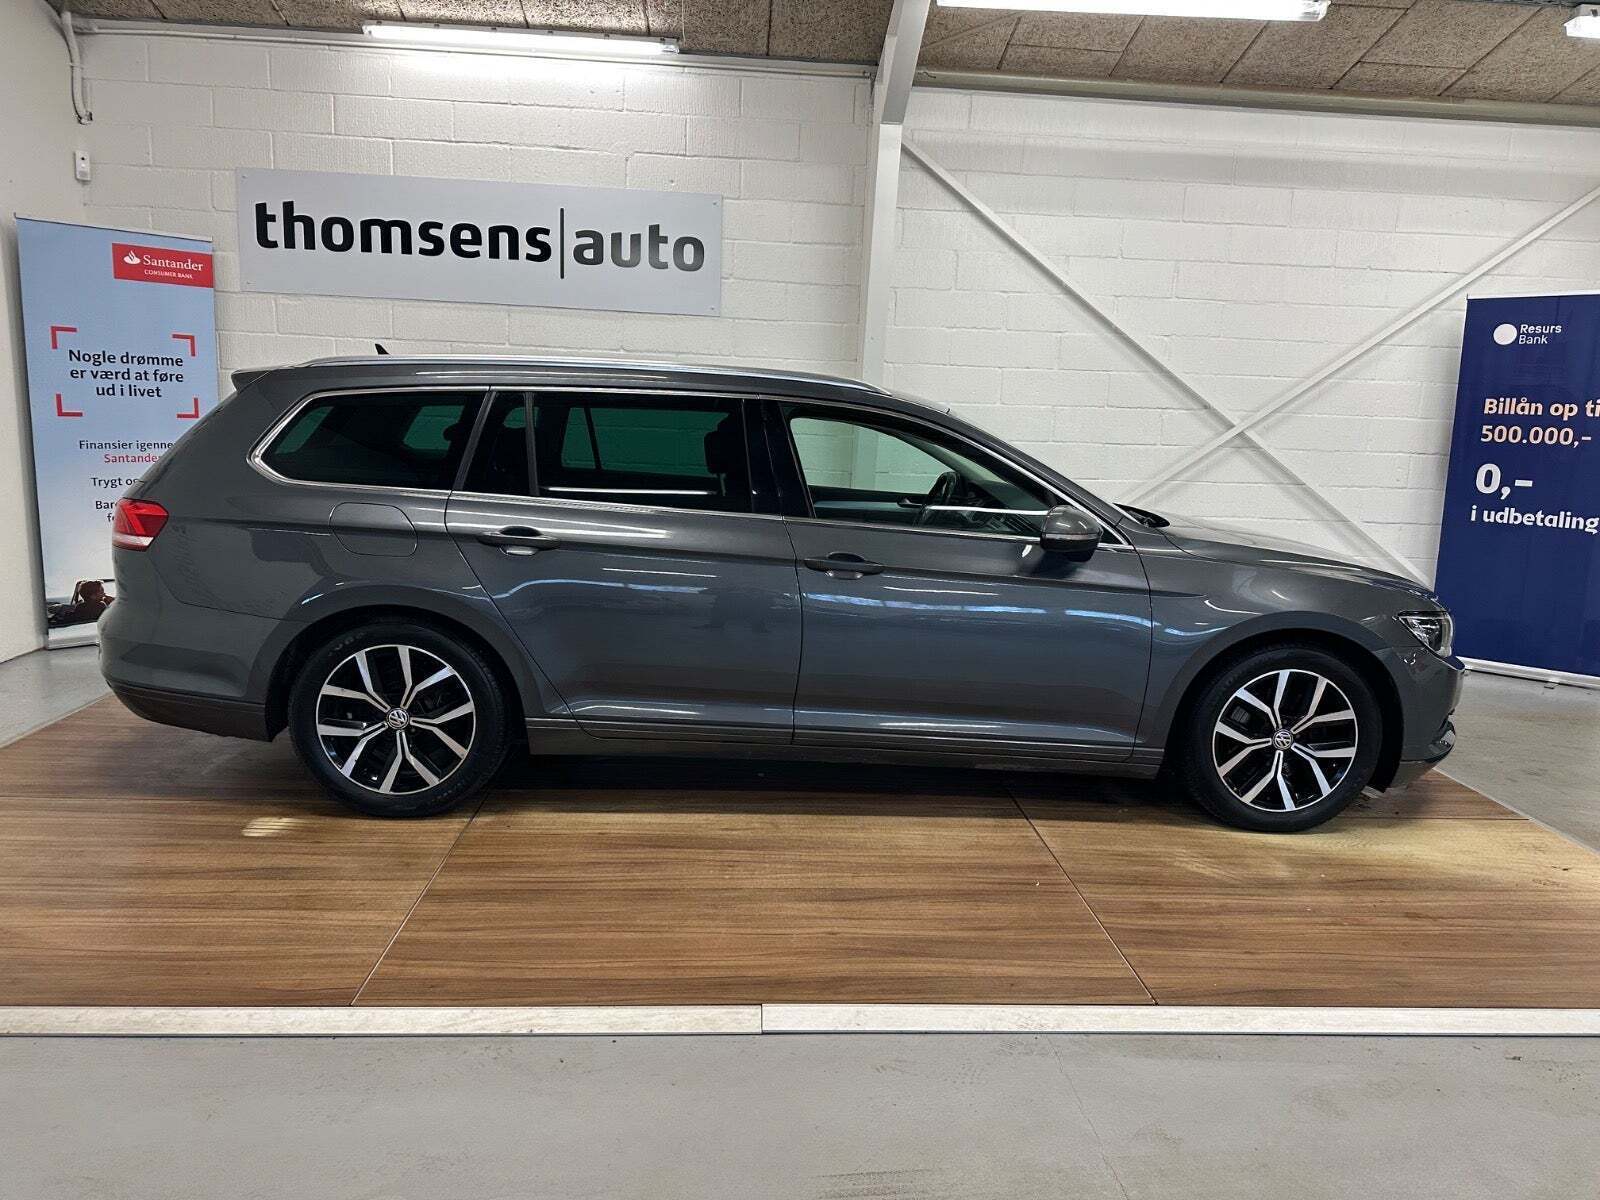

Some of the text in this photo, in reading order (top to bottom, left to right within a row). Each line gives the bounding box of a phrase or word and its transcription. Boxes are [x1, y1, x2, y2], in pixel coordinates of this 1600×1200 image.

[572, 223, 705, 272] auto
[143, 254, 204, 271] Santander
[144, 269, 177, 277] CONSUMER
[1519, 323, 1562, 334] Resurs
[1518, 334, 1549, 345] Bank
[68, 349, 184, 367] Nogle drømme
[70, 367, 184, 383] er værd at føre
[96, 384, 162, 398] ud i livet
[1483, 396, 1543, 416] Billån
[1549, 403, 1578, 421] op
[1480, 424, 1592, 448] 500.000,-
[79, 440, 175, 452] Finansier igenne
[104, 453, 160, 464] Santande
[90, 477, 123, 489] Trygt
[95, 500, 117, 510] Bar
[1470, 505, 1600, 535] i udbetaling
